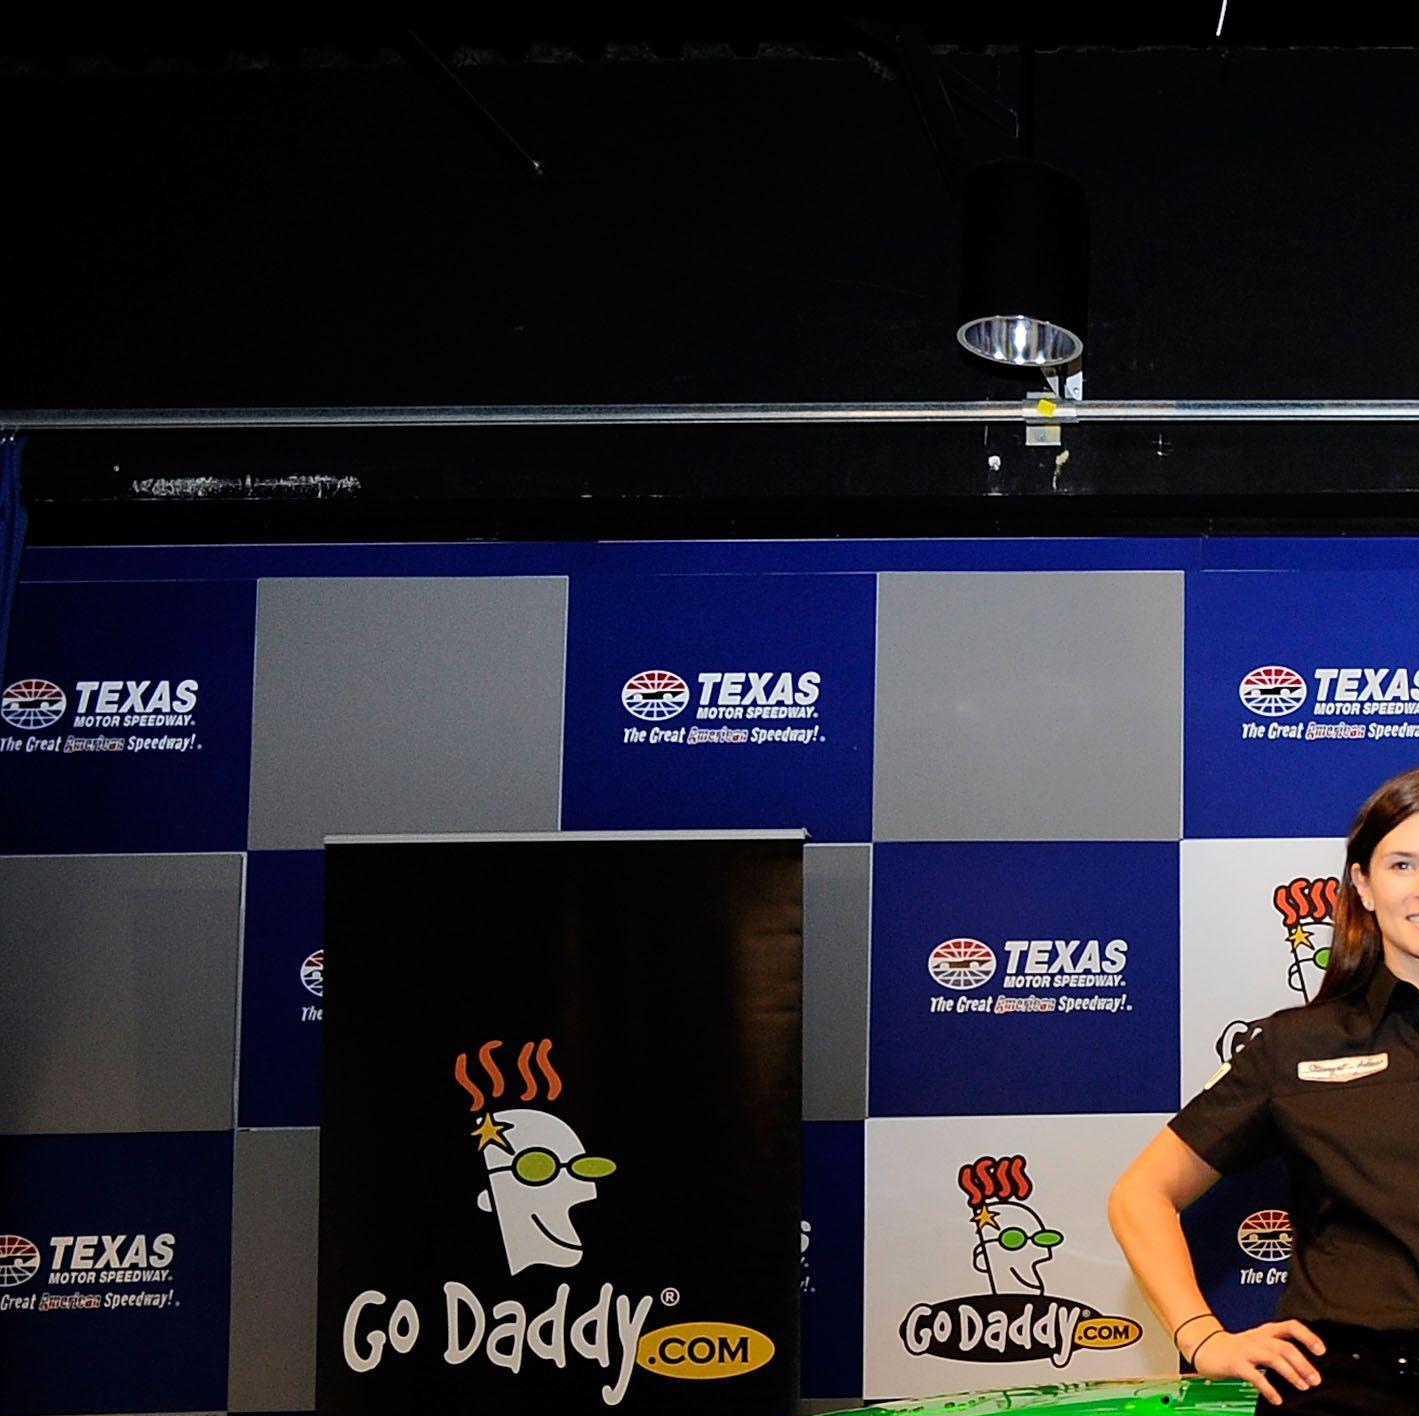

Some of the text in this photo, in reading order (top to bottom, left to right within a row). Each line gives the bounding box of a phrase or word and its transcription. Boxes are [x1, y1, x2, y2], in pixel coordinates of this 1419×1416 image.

[74, 680, 199, 713] TEXAS
[697, 672, 821, 705] TEXAS
[696, 707, 743, 719] MOTOR
[1314, 702, 1360, 715] MOTOR
[74, 715, 120, 727] MOTOR
[624, 729, 646, 743] The
[649, 727, 684, 743] Great
[1243, 723, 1265, 739] The
[1268, 723, 1303, 739] Great
[0, 737, 23, 753] The
[26, 736, 62, 752] Great
[1004, 940, 1128, 973] TEXAS
[1004, 975, 1050, 988] MOTOR
[929, 997, 954, 1013] The
[957, 997, 991, 1013] Great
[50, 1233, 175, 1269] TEXAS
[48, 1272, 96, 1284] MOTOR
[1240, 1268, 1287, 1285] The Gre
[906, 1302, 1131, 1366] Go Daddy .COM
[343, 1281, 749, 1405] Go Daddy .COM
